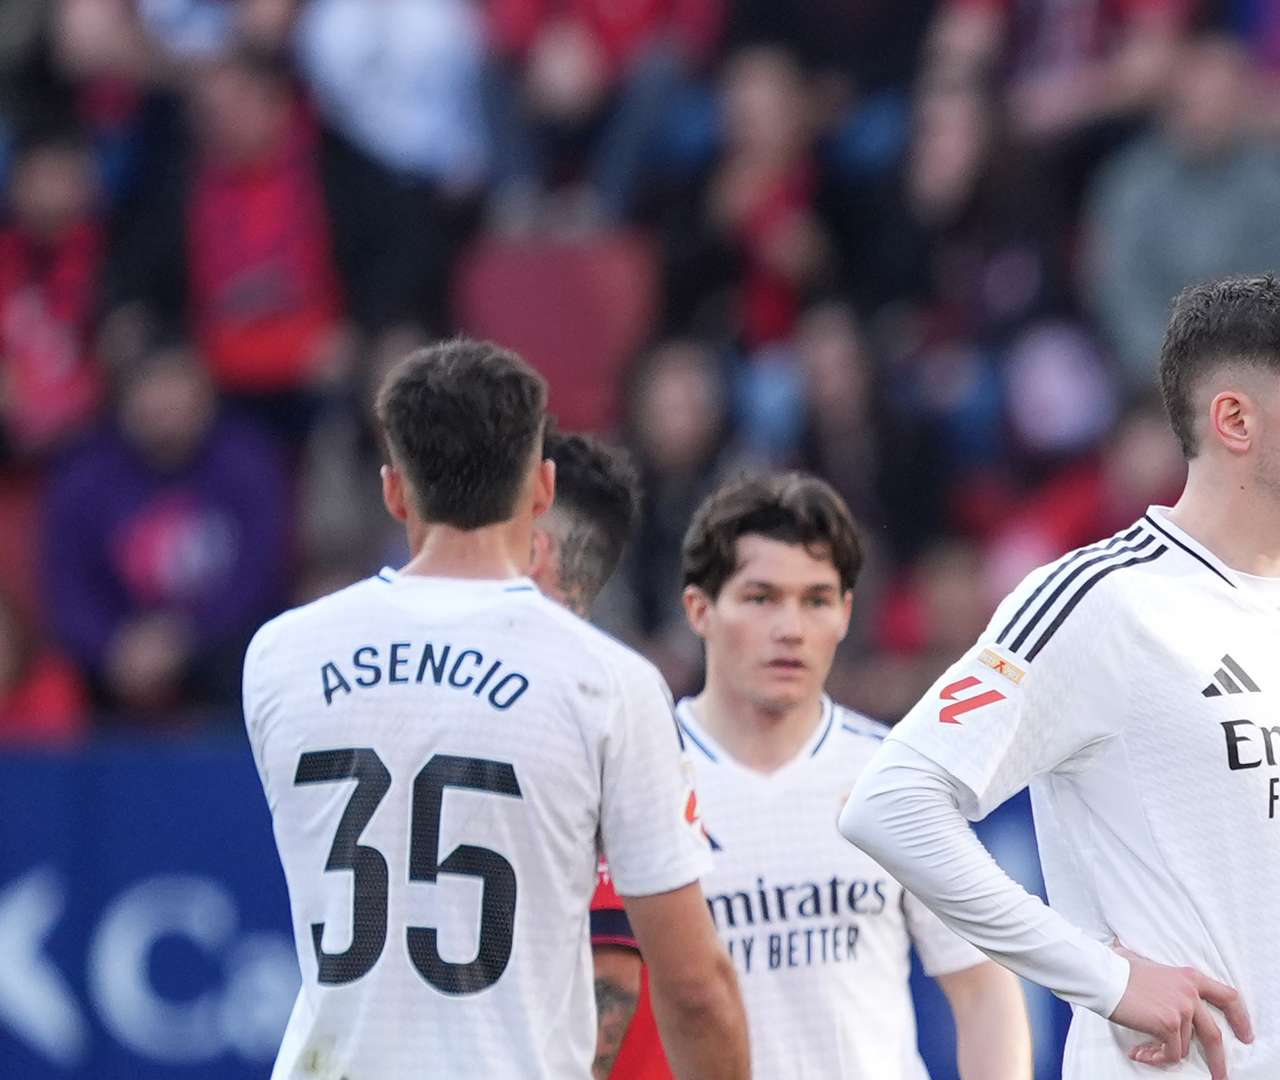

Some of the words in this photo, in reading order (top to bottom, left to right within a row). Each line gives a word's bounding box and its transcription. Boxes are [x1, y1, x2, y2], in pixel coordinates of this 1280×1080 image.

[319, 642, 530, 711] ASENCIO
[293, 747, 524, 997] 35
[706, 873, 887, 927] mirates
[768, 924, 860, 970] BETTER
